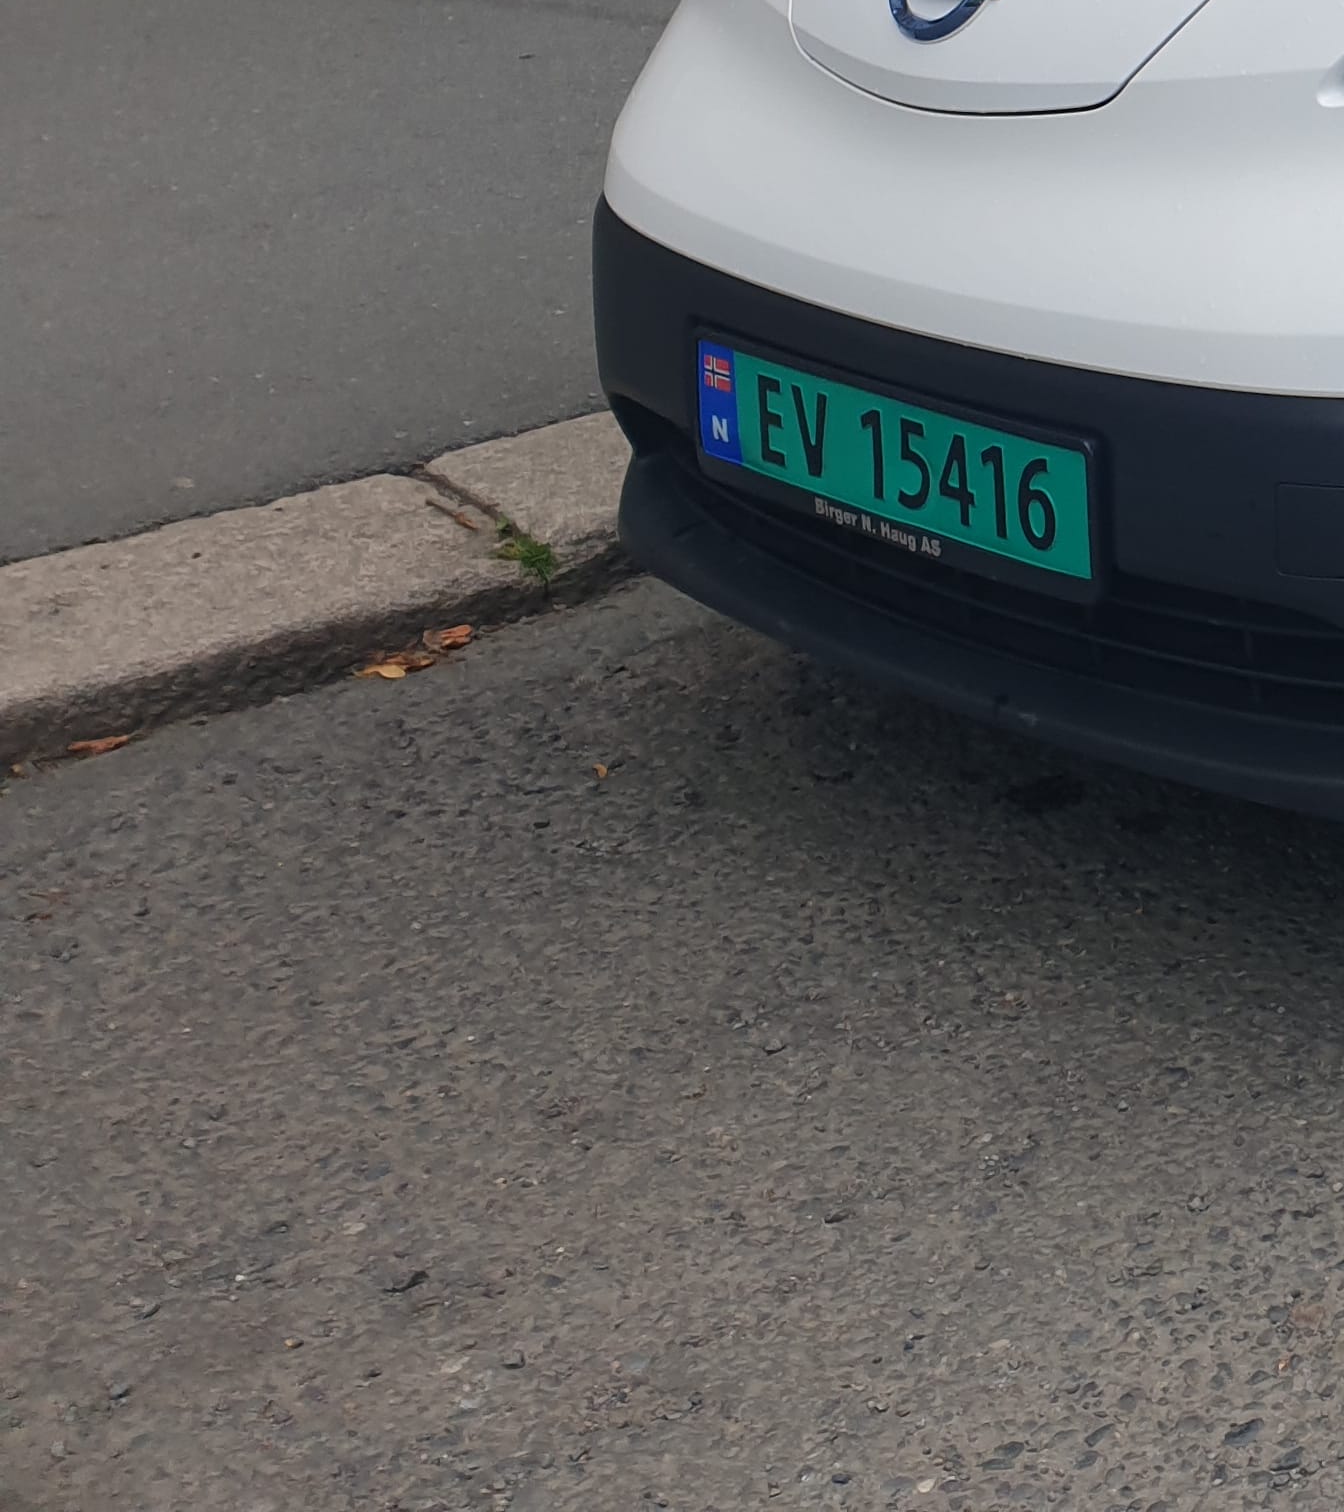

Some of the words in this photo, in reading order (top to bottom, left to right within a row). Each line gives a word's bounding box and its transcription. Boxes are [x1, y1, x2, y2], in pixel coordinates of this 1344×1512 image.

[712, 415, 729, 443] N
[757, 373, 828, 478] EV
[860, 409, 1056, 551] 15416
[814, 498, 857, 526] Birger
[861, 514, 877, 534] N.
[880, 521, 916, 552] Haug
[921, 536, 942, 557] AS
